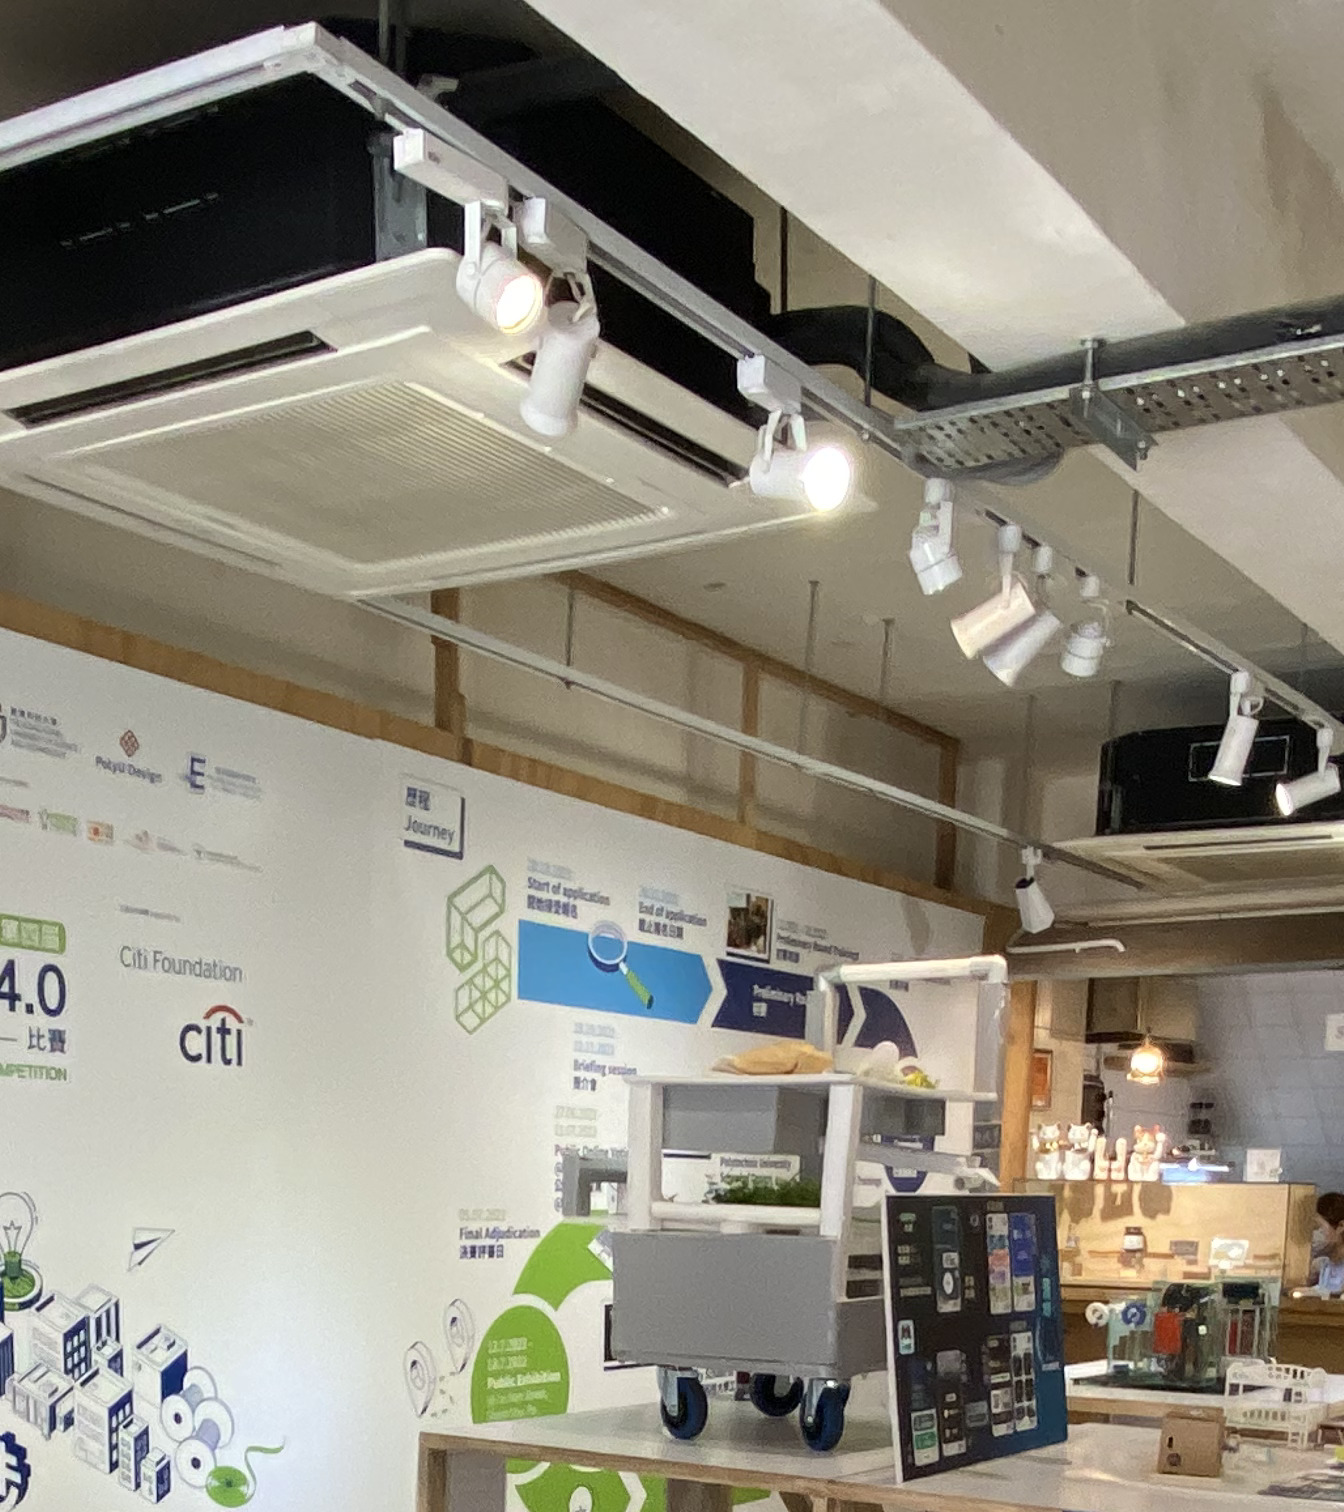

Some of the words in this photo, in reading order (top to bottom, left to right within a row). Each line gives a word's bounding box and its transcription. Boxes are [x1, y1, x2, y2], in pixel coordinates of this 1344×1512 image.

[404, 815, 456, 844] Journey
[119, 945, 148, 970] Citi
[152, 950, 244, 982] Foundation
[28, 1027, 67, 1053] 比賽
[459, 1226, 483, 1240] Final
[484, 1227, 540, 1242] Adjudication
